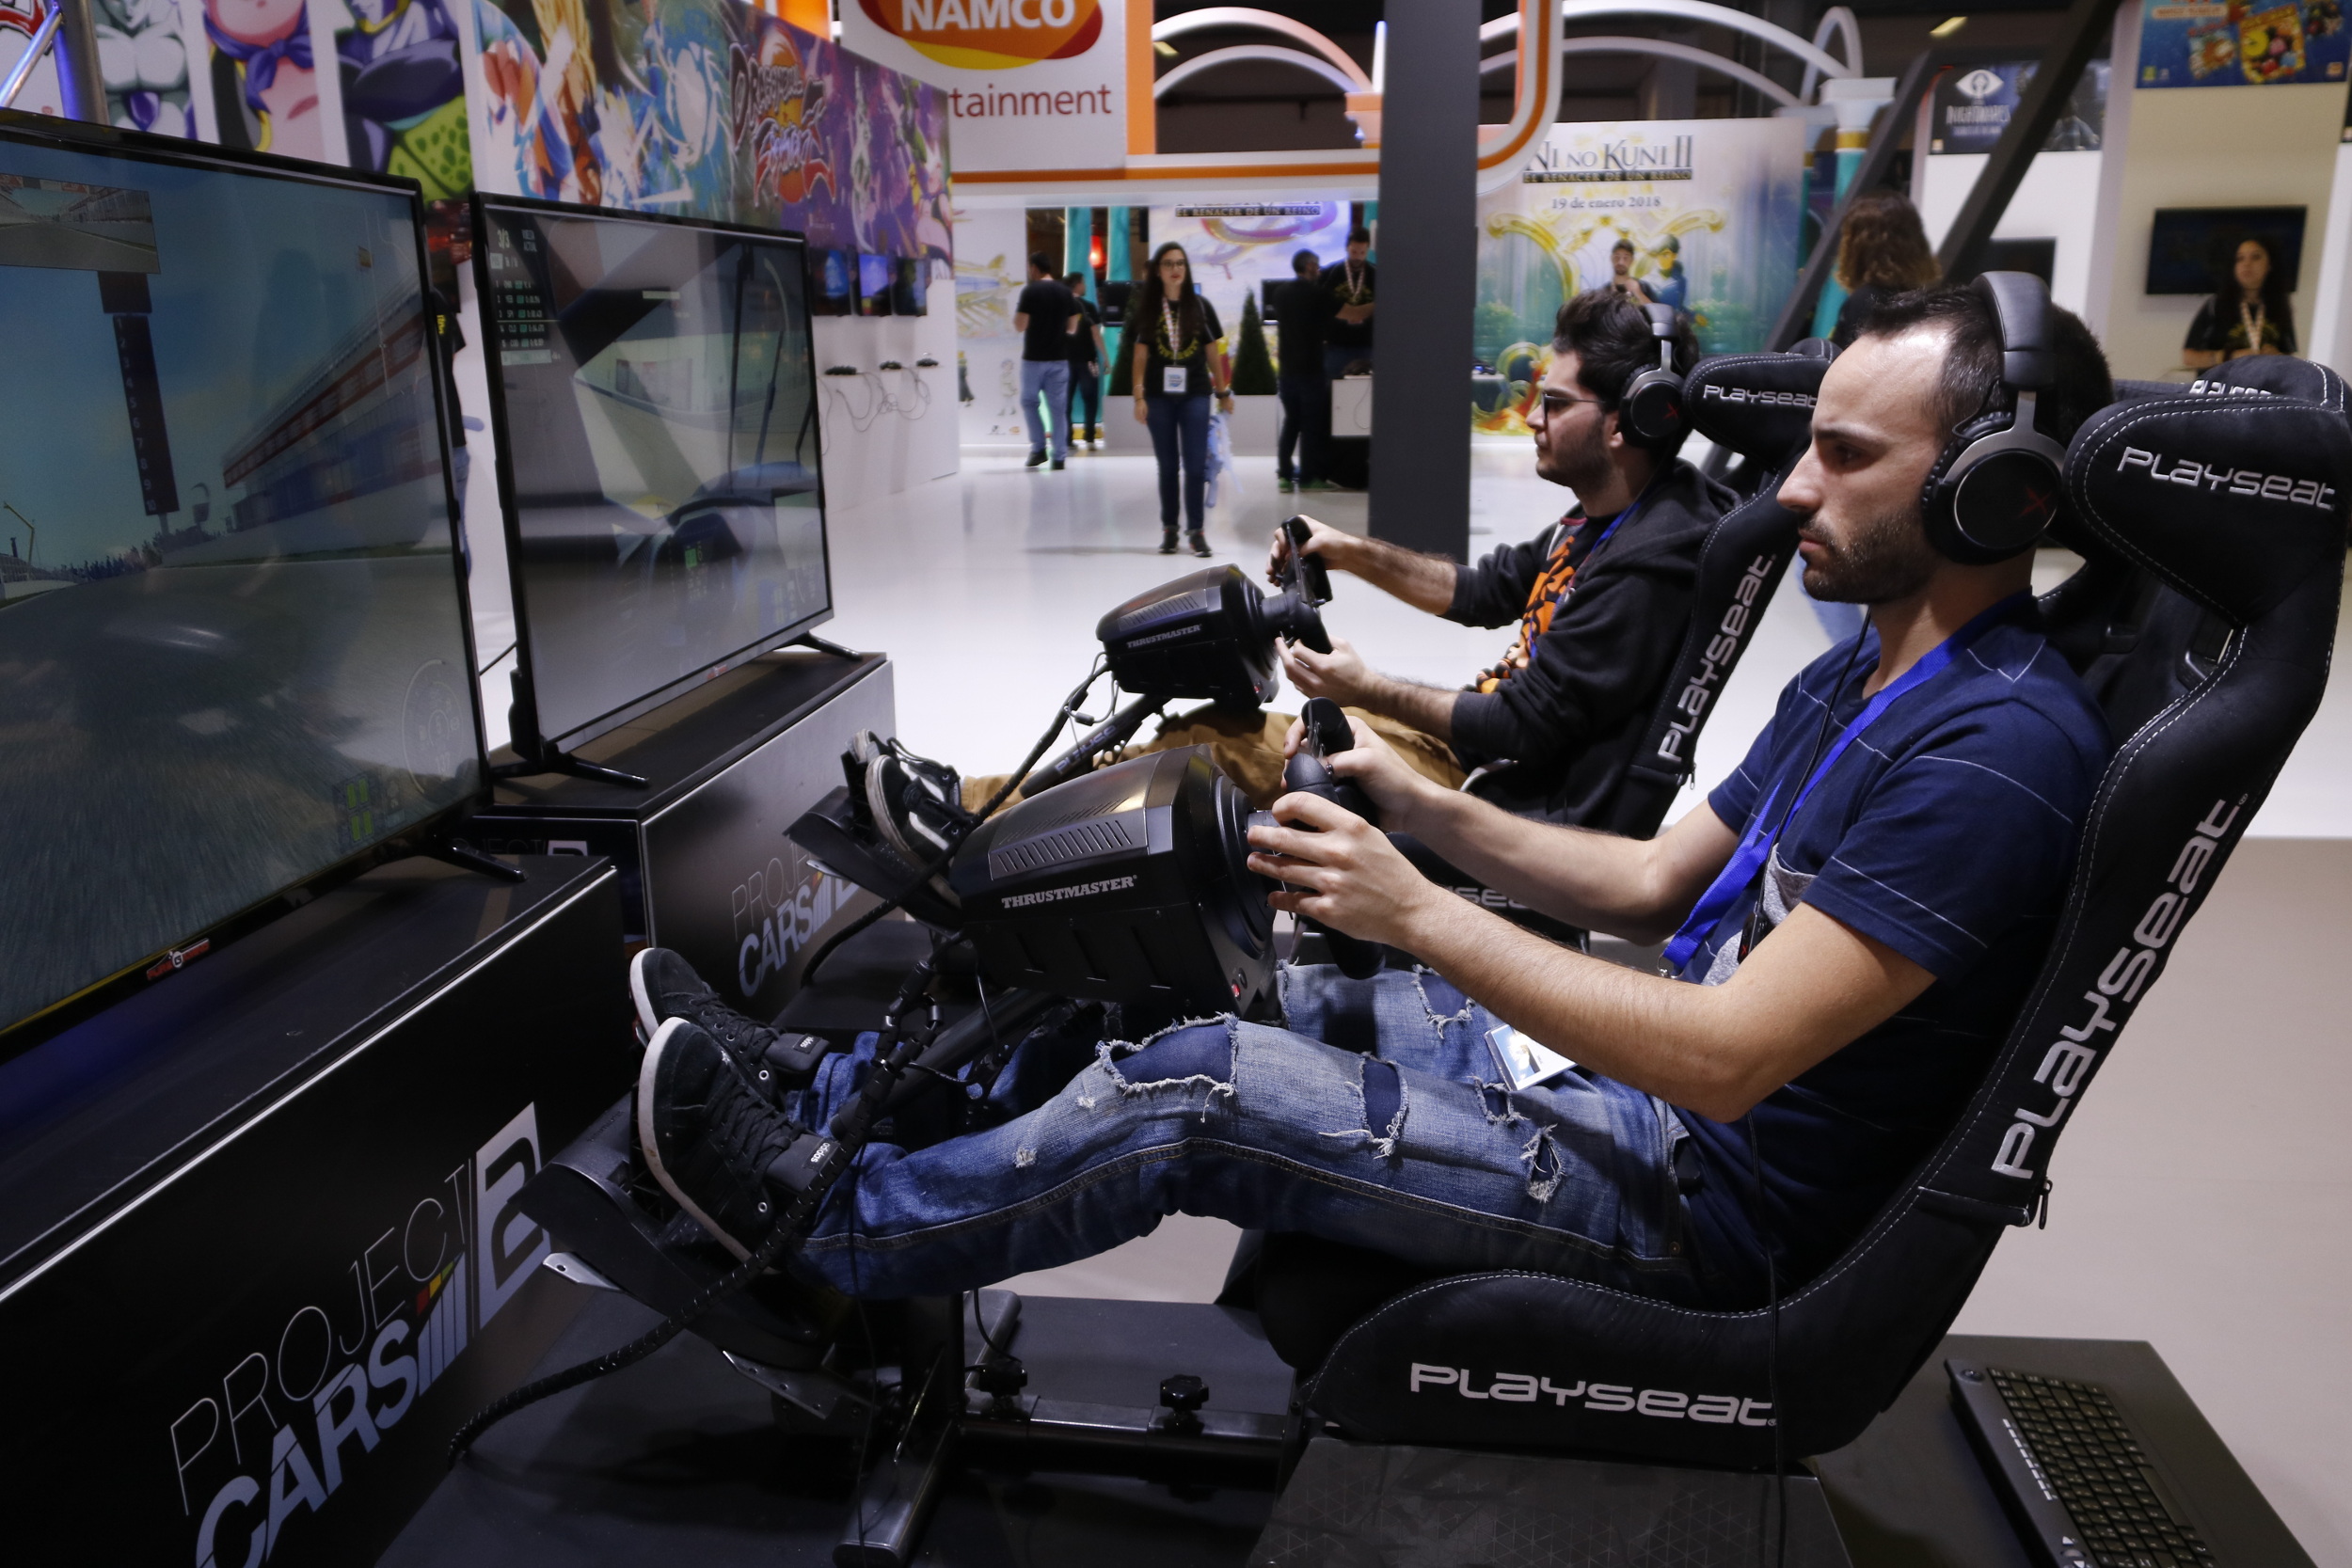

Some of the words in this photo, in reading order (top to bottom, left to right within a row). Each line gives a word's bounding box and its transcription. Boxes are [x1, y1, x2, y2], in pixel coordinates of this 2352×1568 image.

[901, 0, 1075, 31] NAMCO
[1603, 139, 1667, 172] KUNI
[1193, 207, 1242, 216] RENACER
[1245, 207, 1260, 215] DE
[1263, 206, 1280, 215] UN
[1284, 206, 1319, 215] REINO
[1552, 198, 1567, 209] 19
[1570, 197, 1585, 208] de
[1588, 198, 1626, 208] enero
[1629, 196, 1661, 207] 2018
[1127, 624, 1202, 649] THRUSTMASTER
[1001, 875, 1136, 909] THRUSTMASTER
[738, 883, 814, 998] CARS
[810, 1142, 831, 1164] adidas
[170, 1163, 467, 1516] PROJECT
[195, 1319, 419, 1568] CARS
